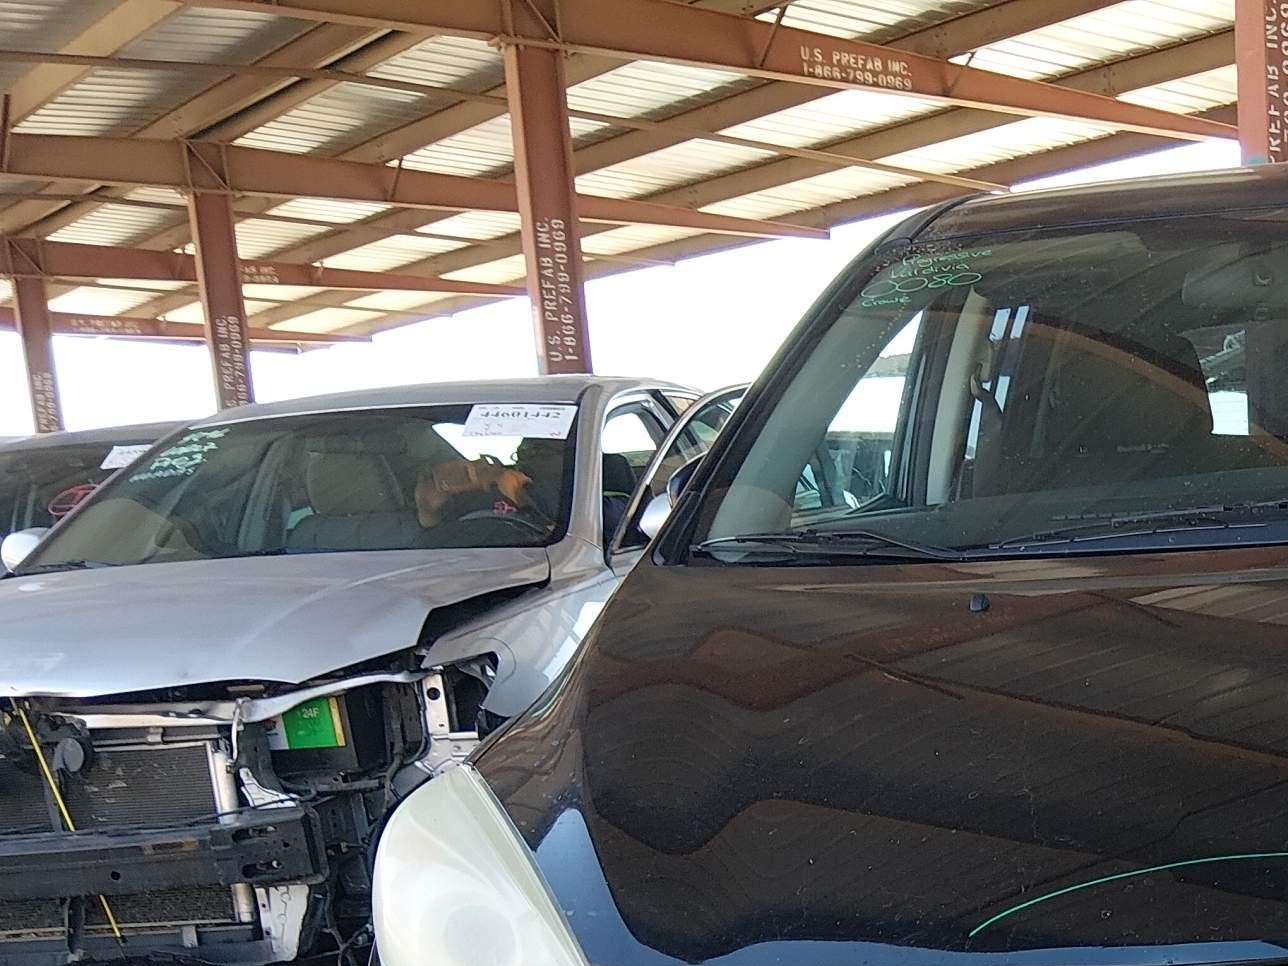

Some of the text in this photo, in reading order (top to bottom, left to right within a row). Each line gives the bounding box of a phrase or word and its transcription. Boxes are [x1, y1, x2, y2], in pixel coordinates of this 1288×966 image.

[832, 51, 883, 72] PREFAB
[887, 60, 912, 76] INC.
[536, 216, 551, 248] INC.
[540, 256, 558, 321] PREFAB
[302, 707, 320, 719] 24F
